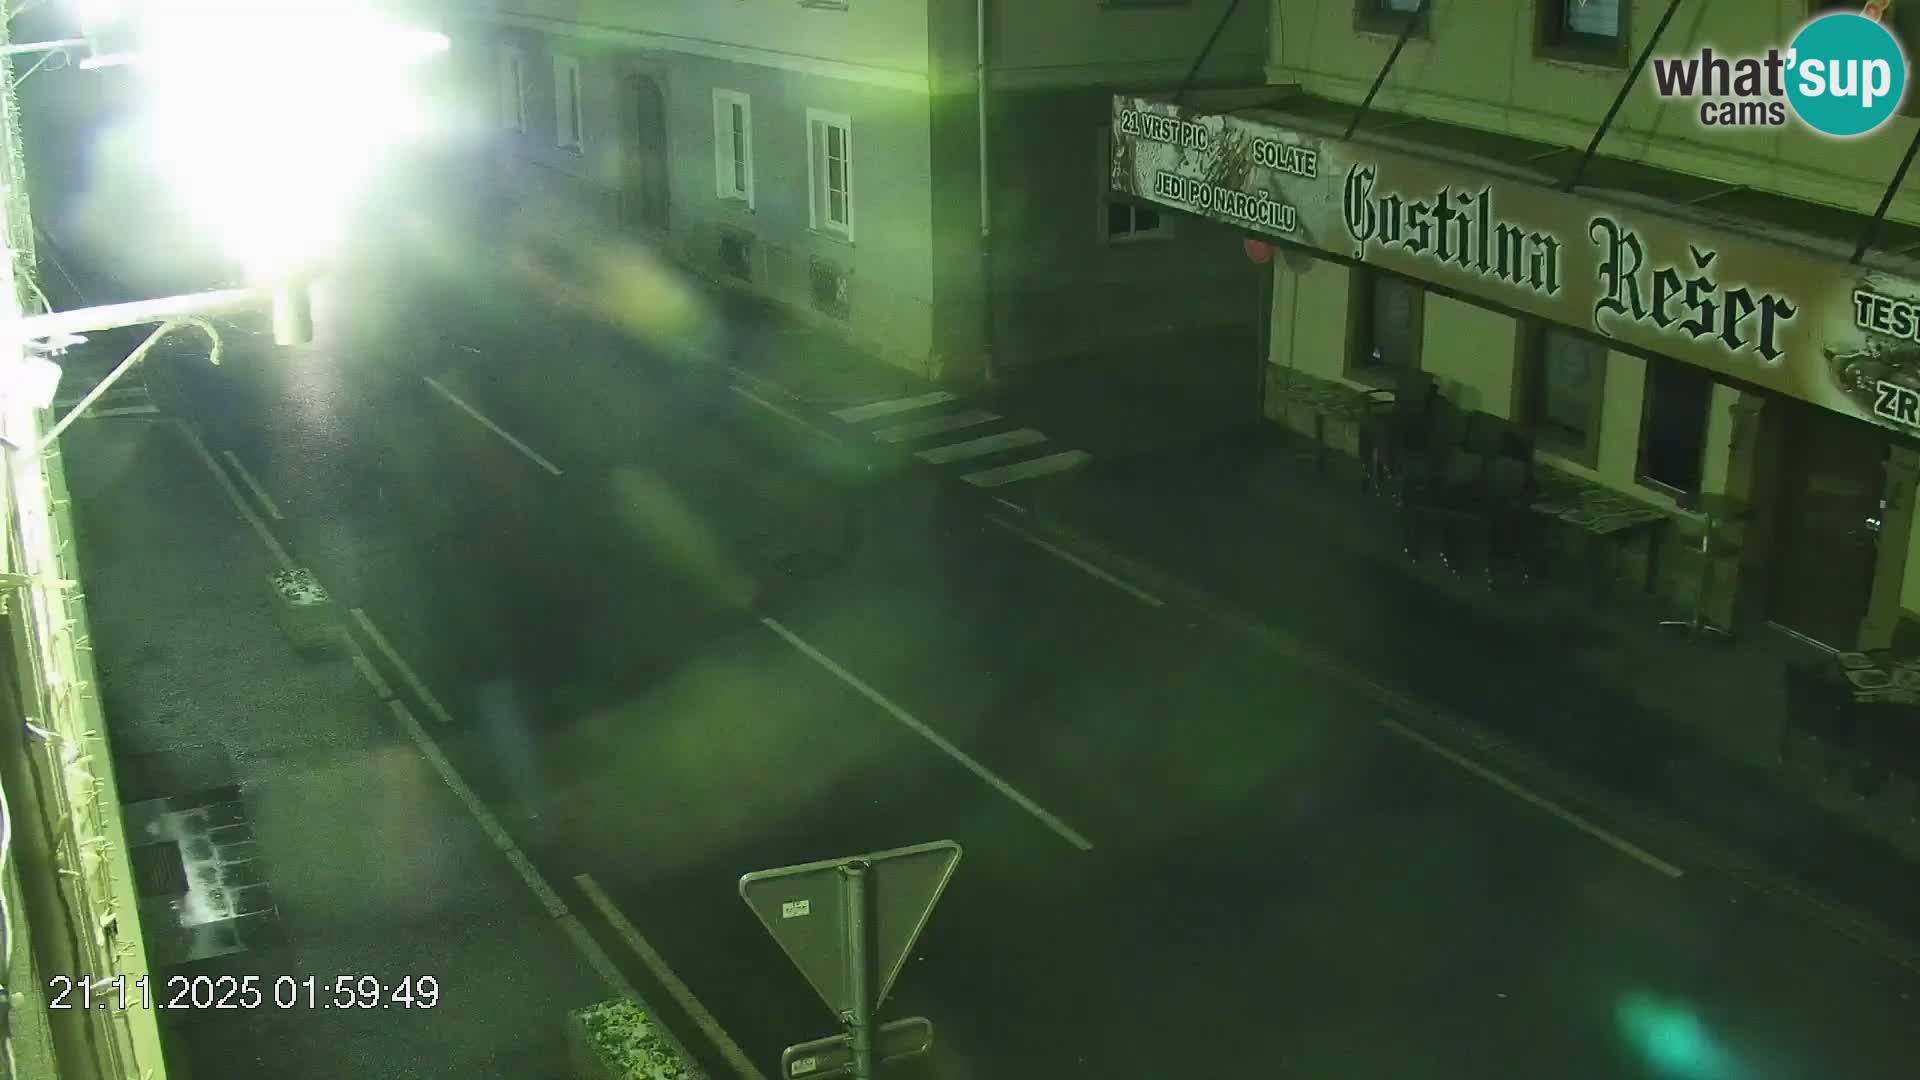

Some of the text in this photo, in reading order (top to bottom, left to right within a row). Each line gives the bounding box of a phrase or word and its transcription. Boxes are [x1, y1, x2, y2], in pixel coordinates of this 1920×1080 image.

[1121, 111, 1209, 150] 21 VRST PIC
[1253, 139, 1317, 178] SOLATE
[1155, 171, 1296, 232] JEDI PO NAROČILU
[1344, 163, 1799, 362] Gostilna Rešer
